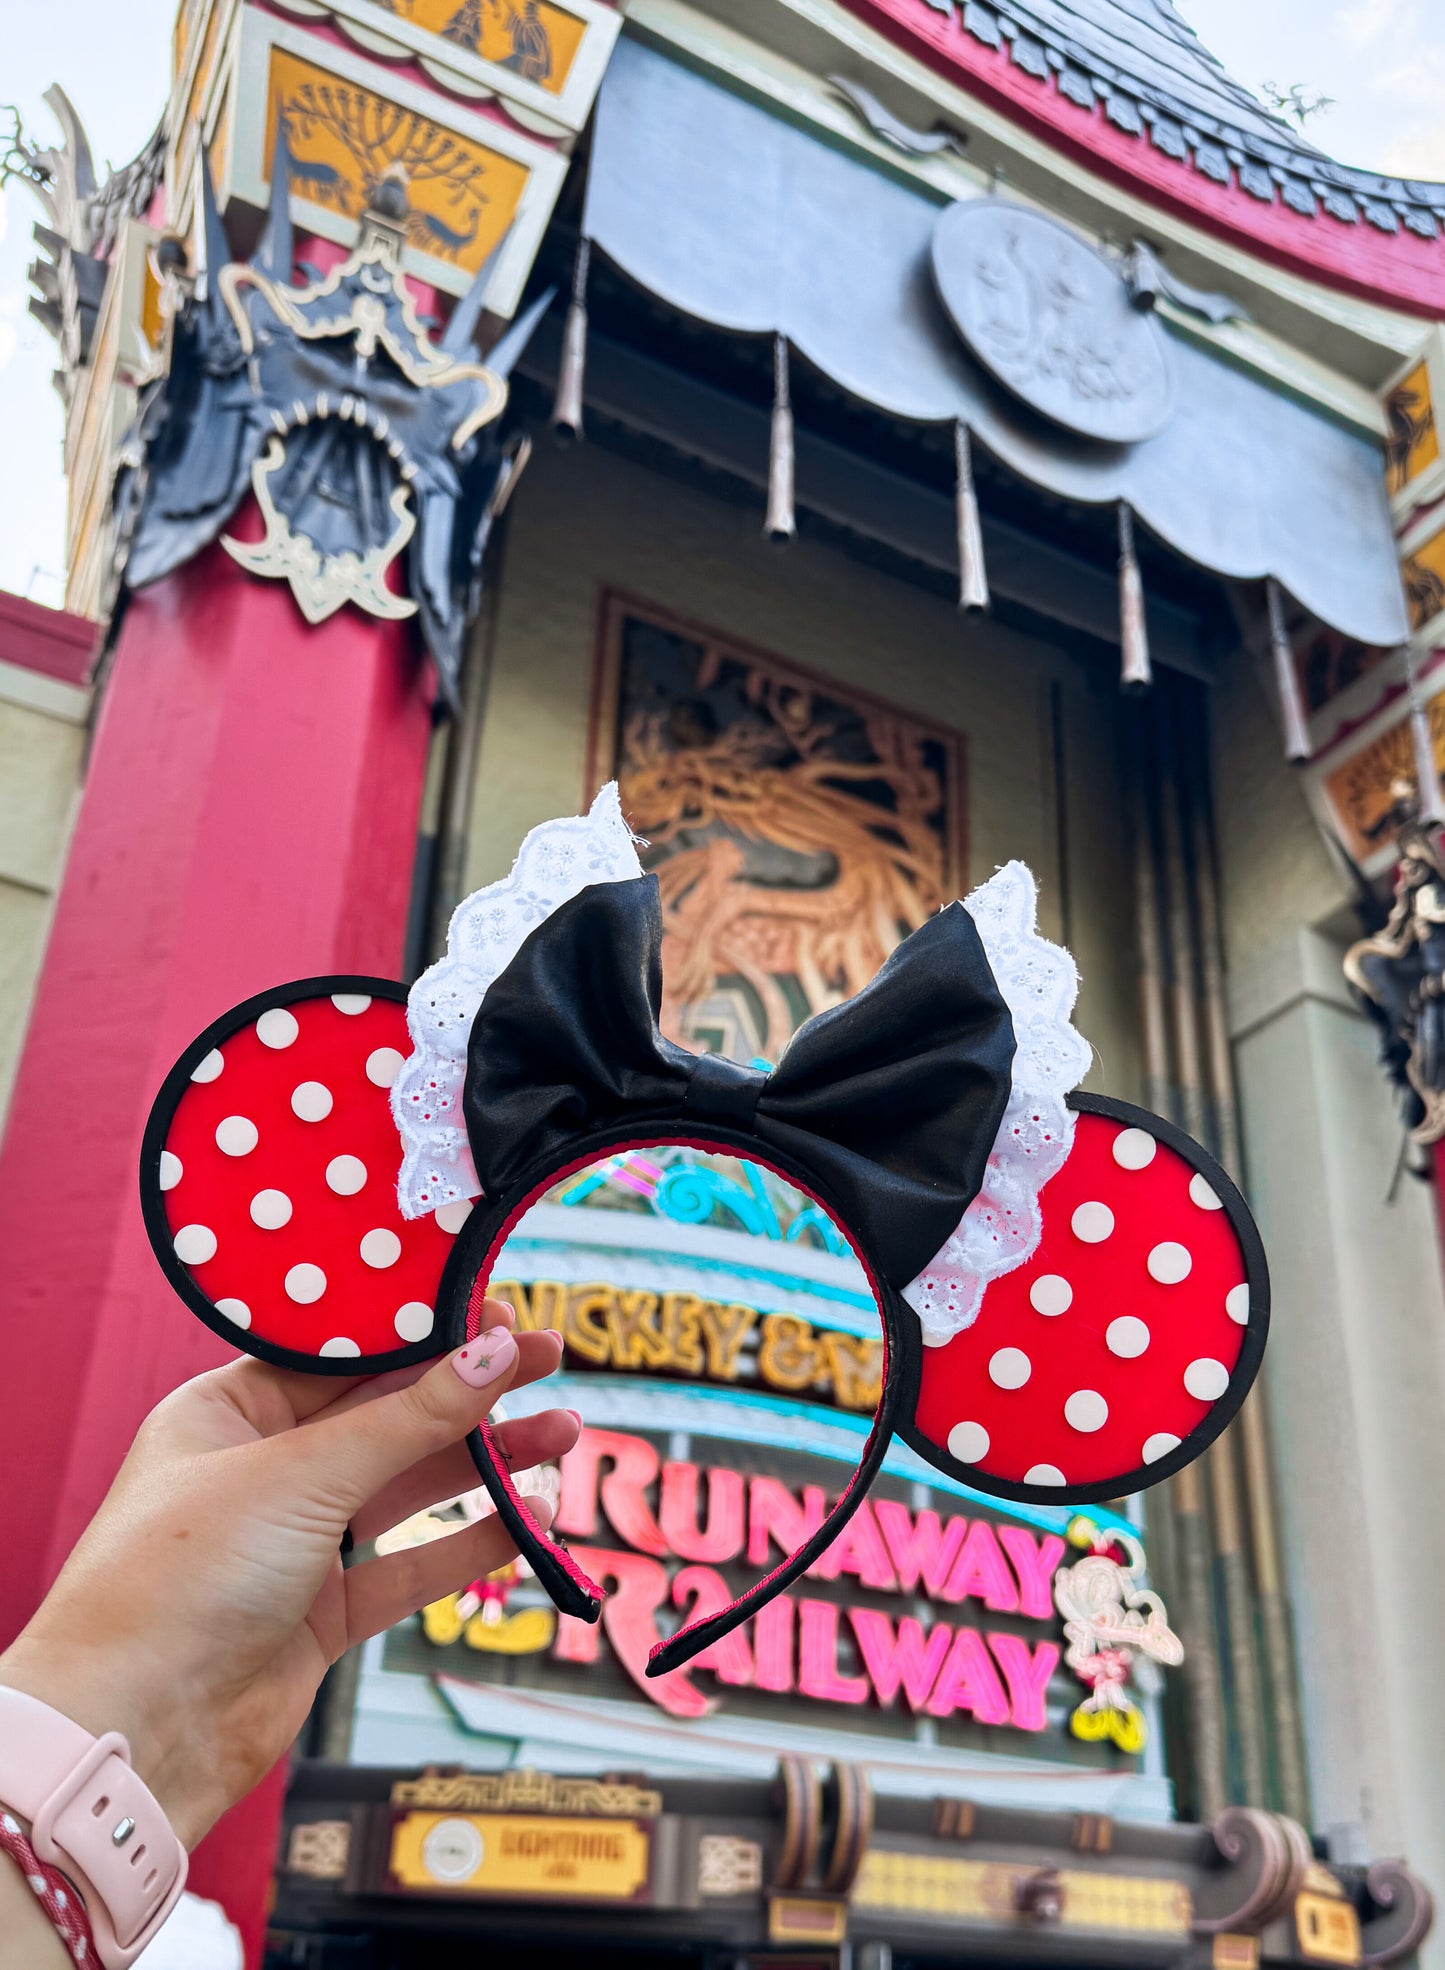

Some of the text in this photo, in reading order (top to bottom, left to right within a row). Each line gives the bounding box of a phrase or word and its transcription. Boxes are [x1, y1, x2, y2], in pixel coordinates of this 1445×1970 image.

[759, 1312, 828, 1390] &
[554, 1427, 1066, 1620] RUNAWAY
[555, 1544, 1060, 1732] RAILWAY
